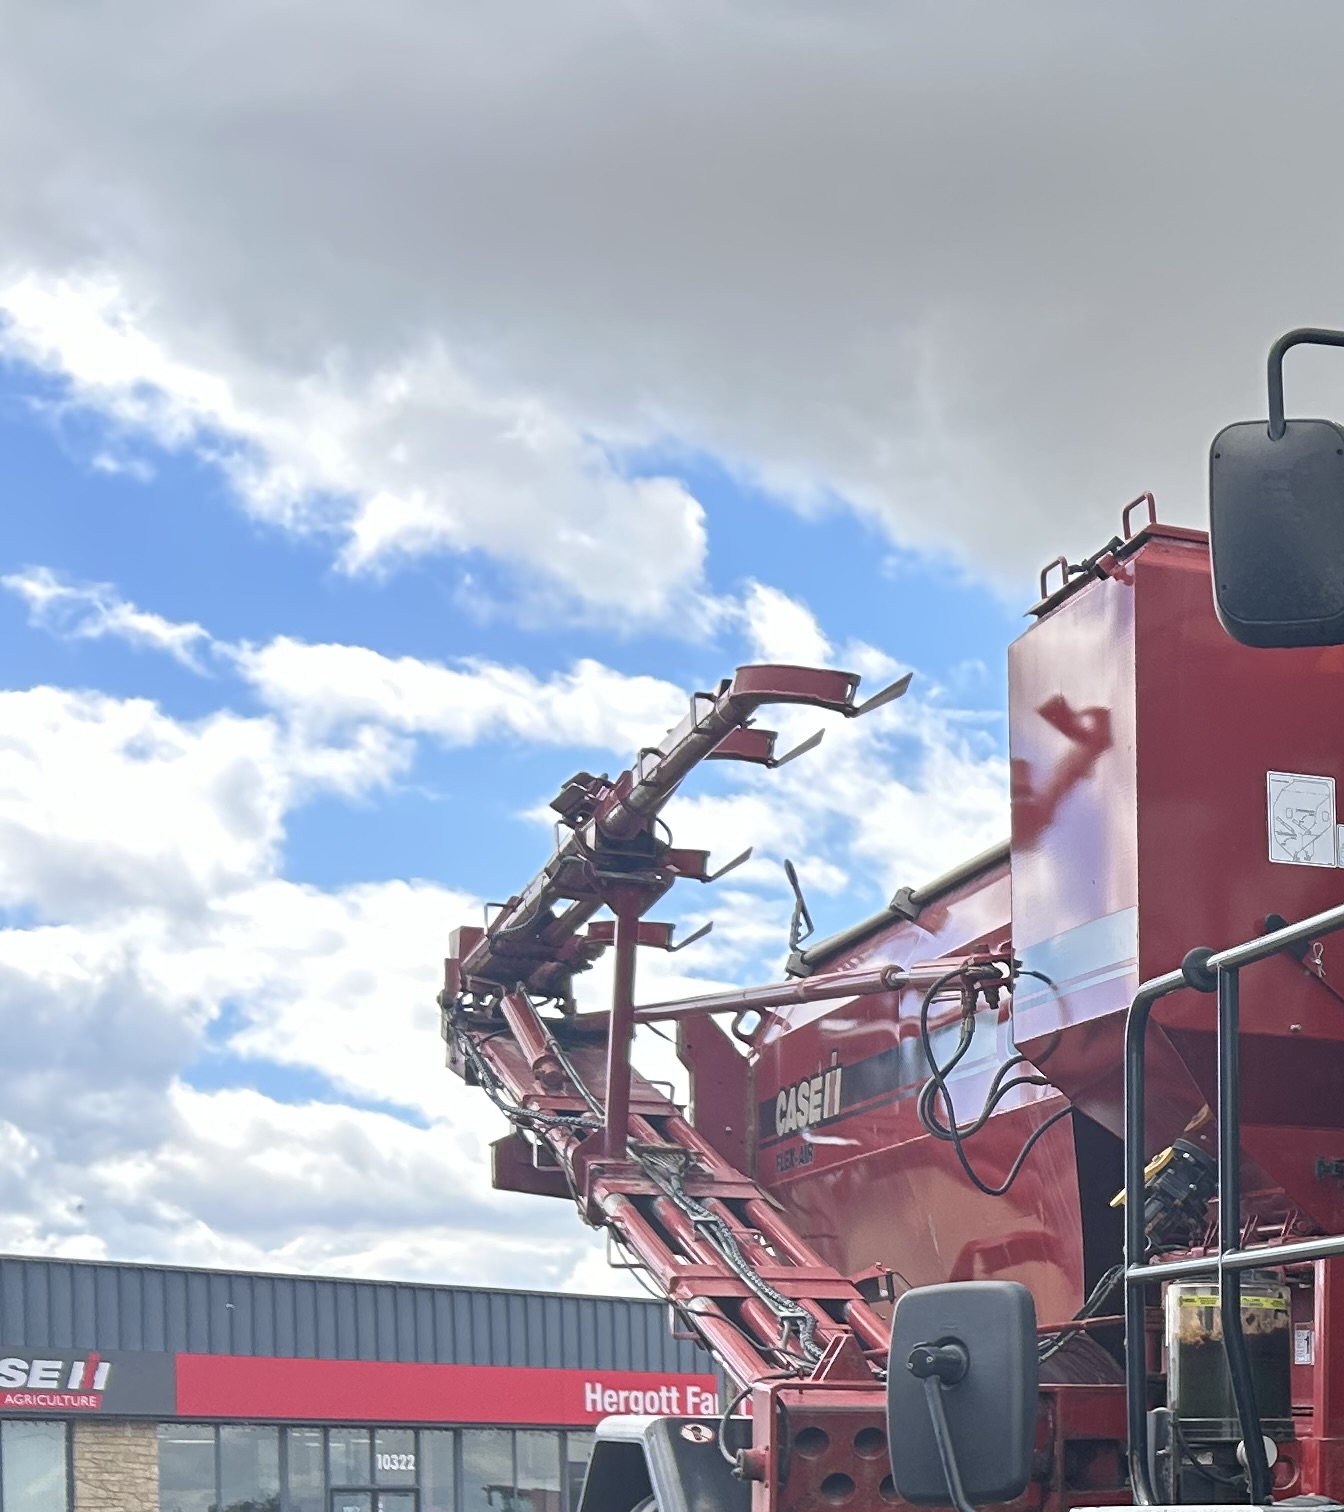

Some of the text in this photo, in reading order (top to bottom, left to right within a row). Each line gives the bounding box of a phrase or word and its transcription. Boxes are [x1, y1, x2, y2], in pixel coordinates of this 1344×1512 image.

[775, 1076, 823, 1137] CASE
[4, 1393, 97, 1408] AGRICULTURE
[584, 1382, 681, 1415] Hergott
[376, 1453, 416, 1471] 10322
